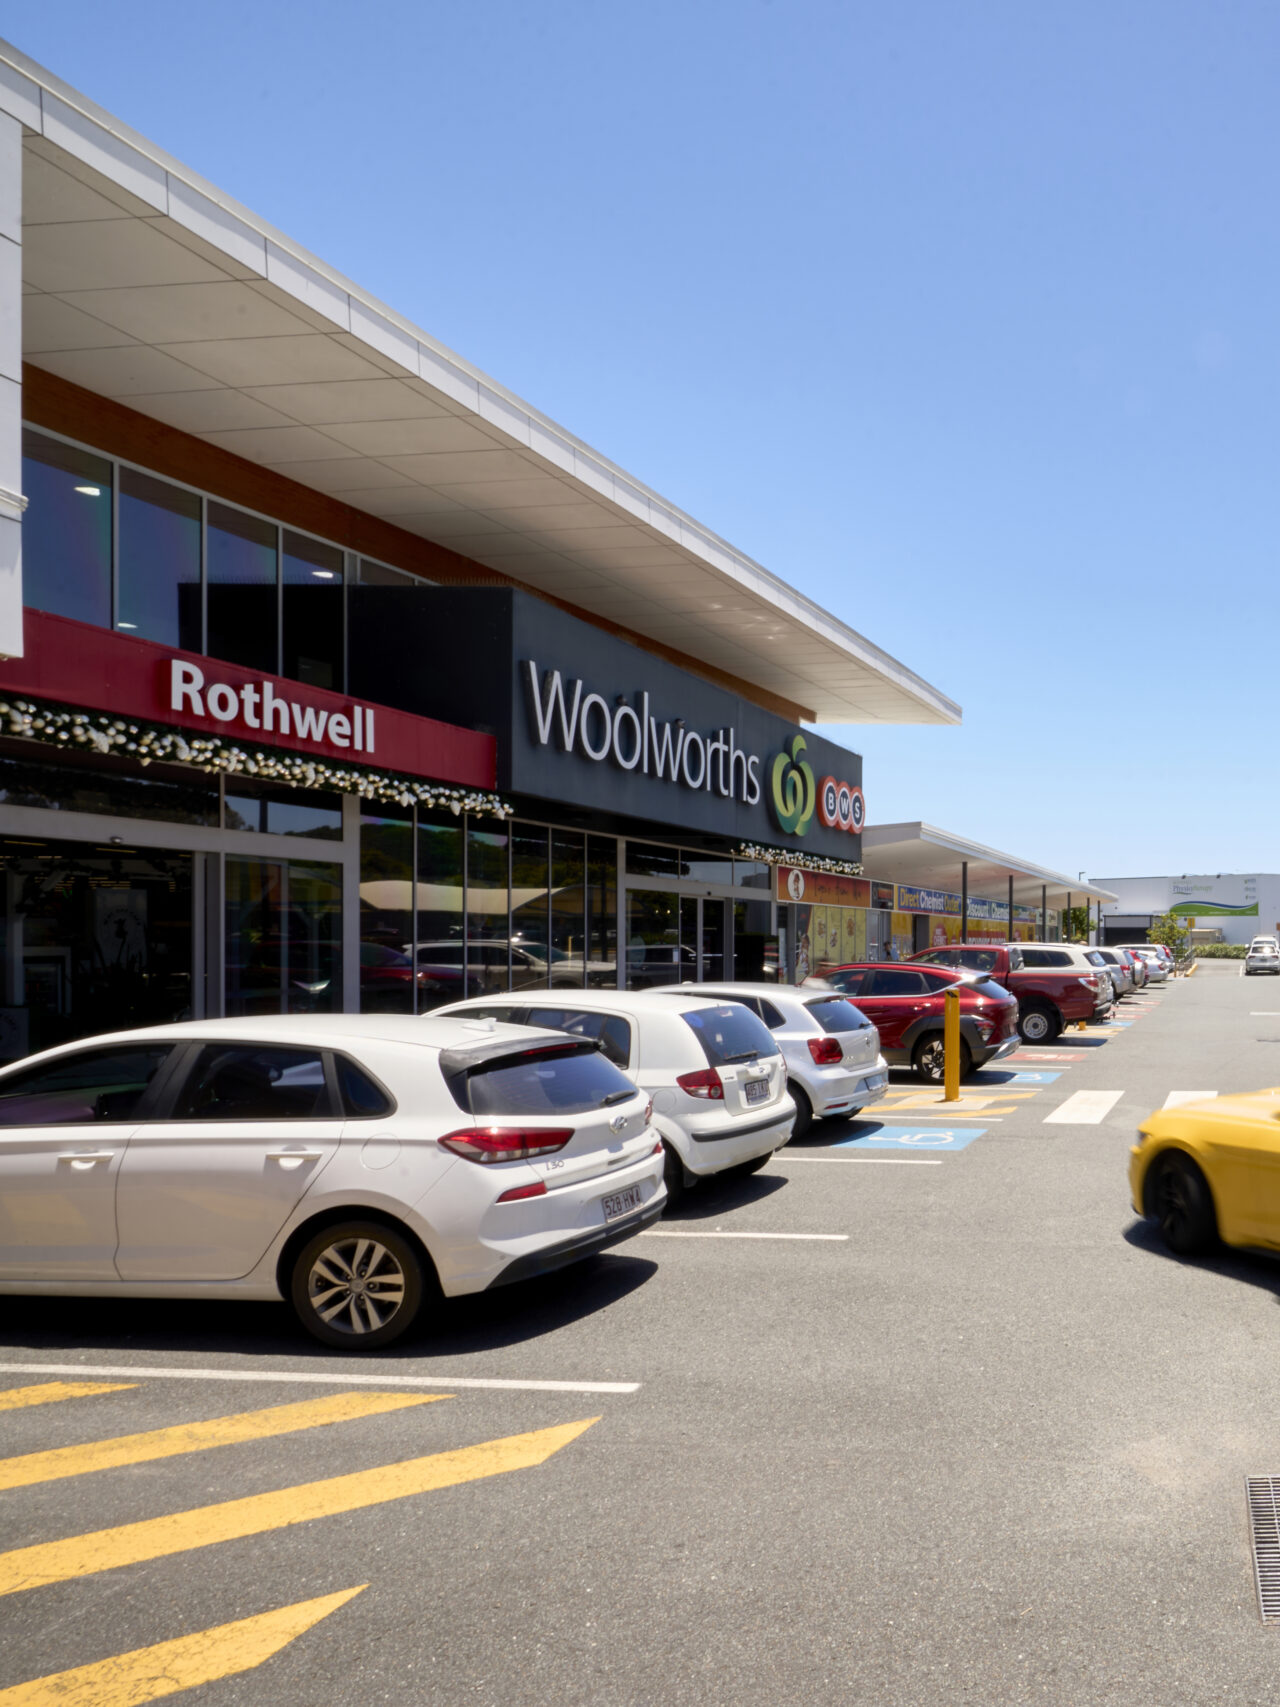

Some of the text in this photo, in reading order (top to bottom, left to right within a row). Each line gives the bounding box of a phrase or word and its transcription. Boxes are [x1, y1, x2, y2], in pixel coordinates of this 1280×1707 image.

[169, 658, 376, 754] Rothwell
[528, 659, 761, 805] Woolworths
[900, 887, 919, 908] Direct
[920, 890, 944, 911] Chemist
